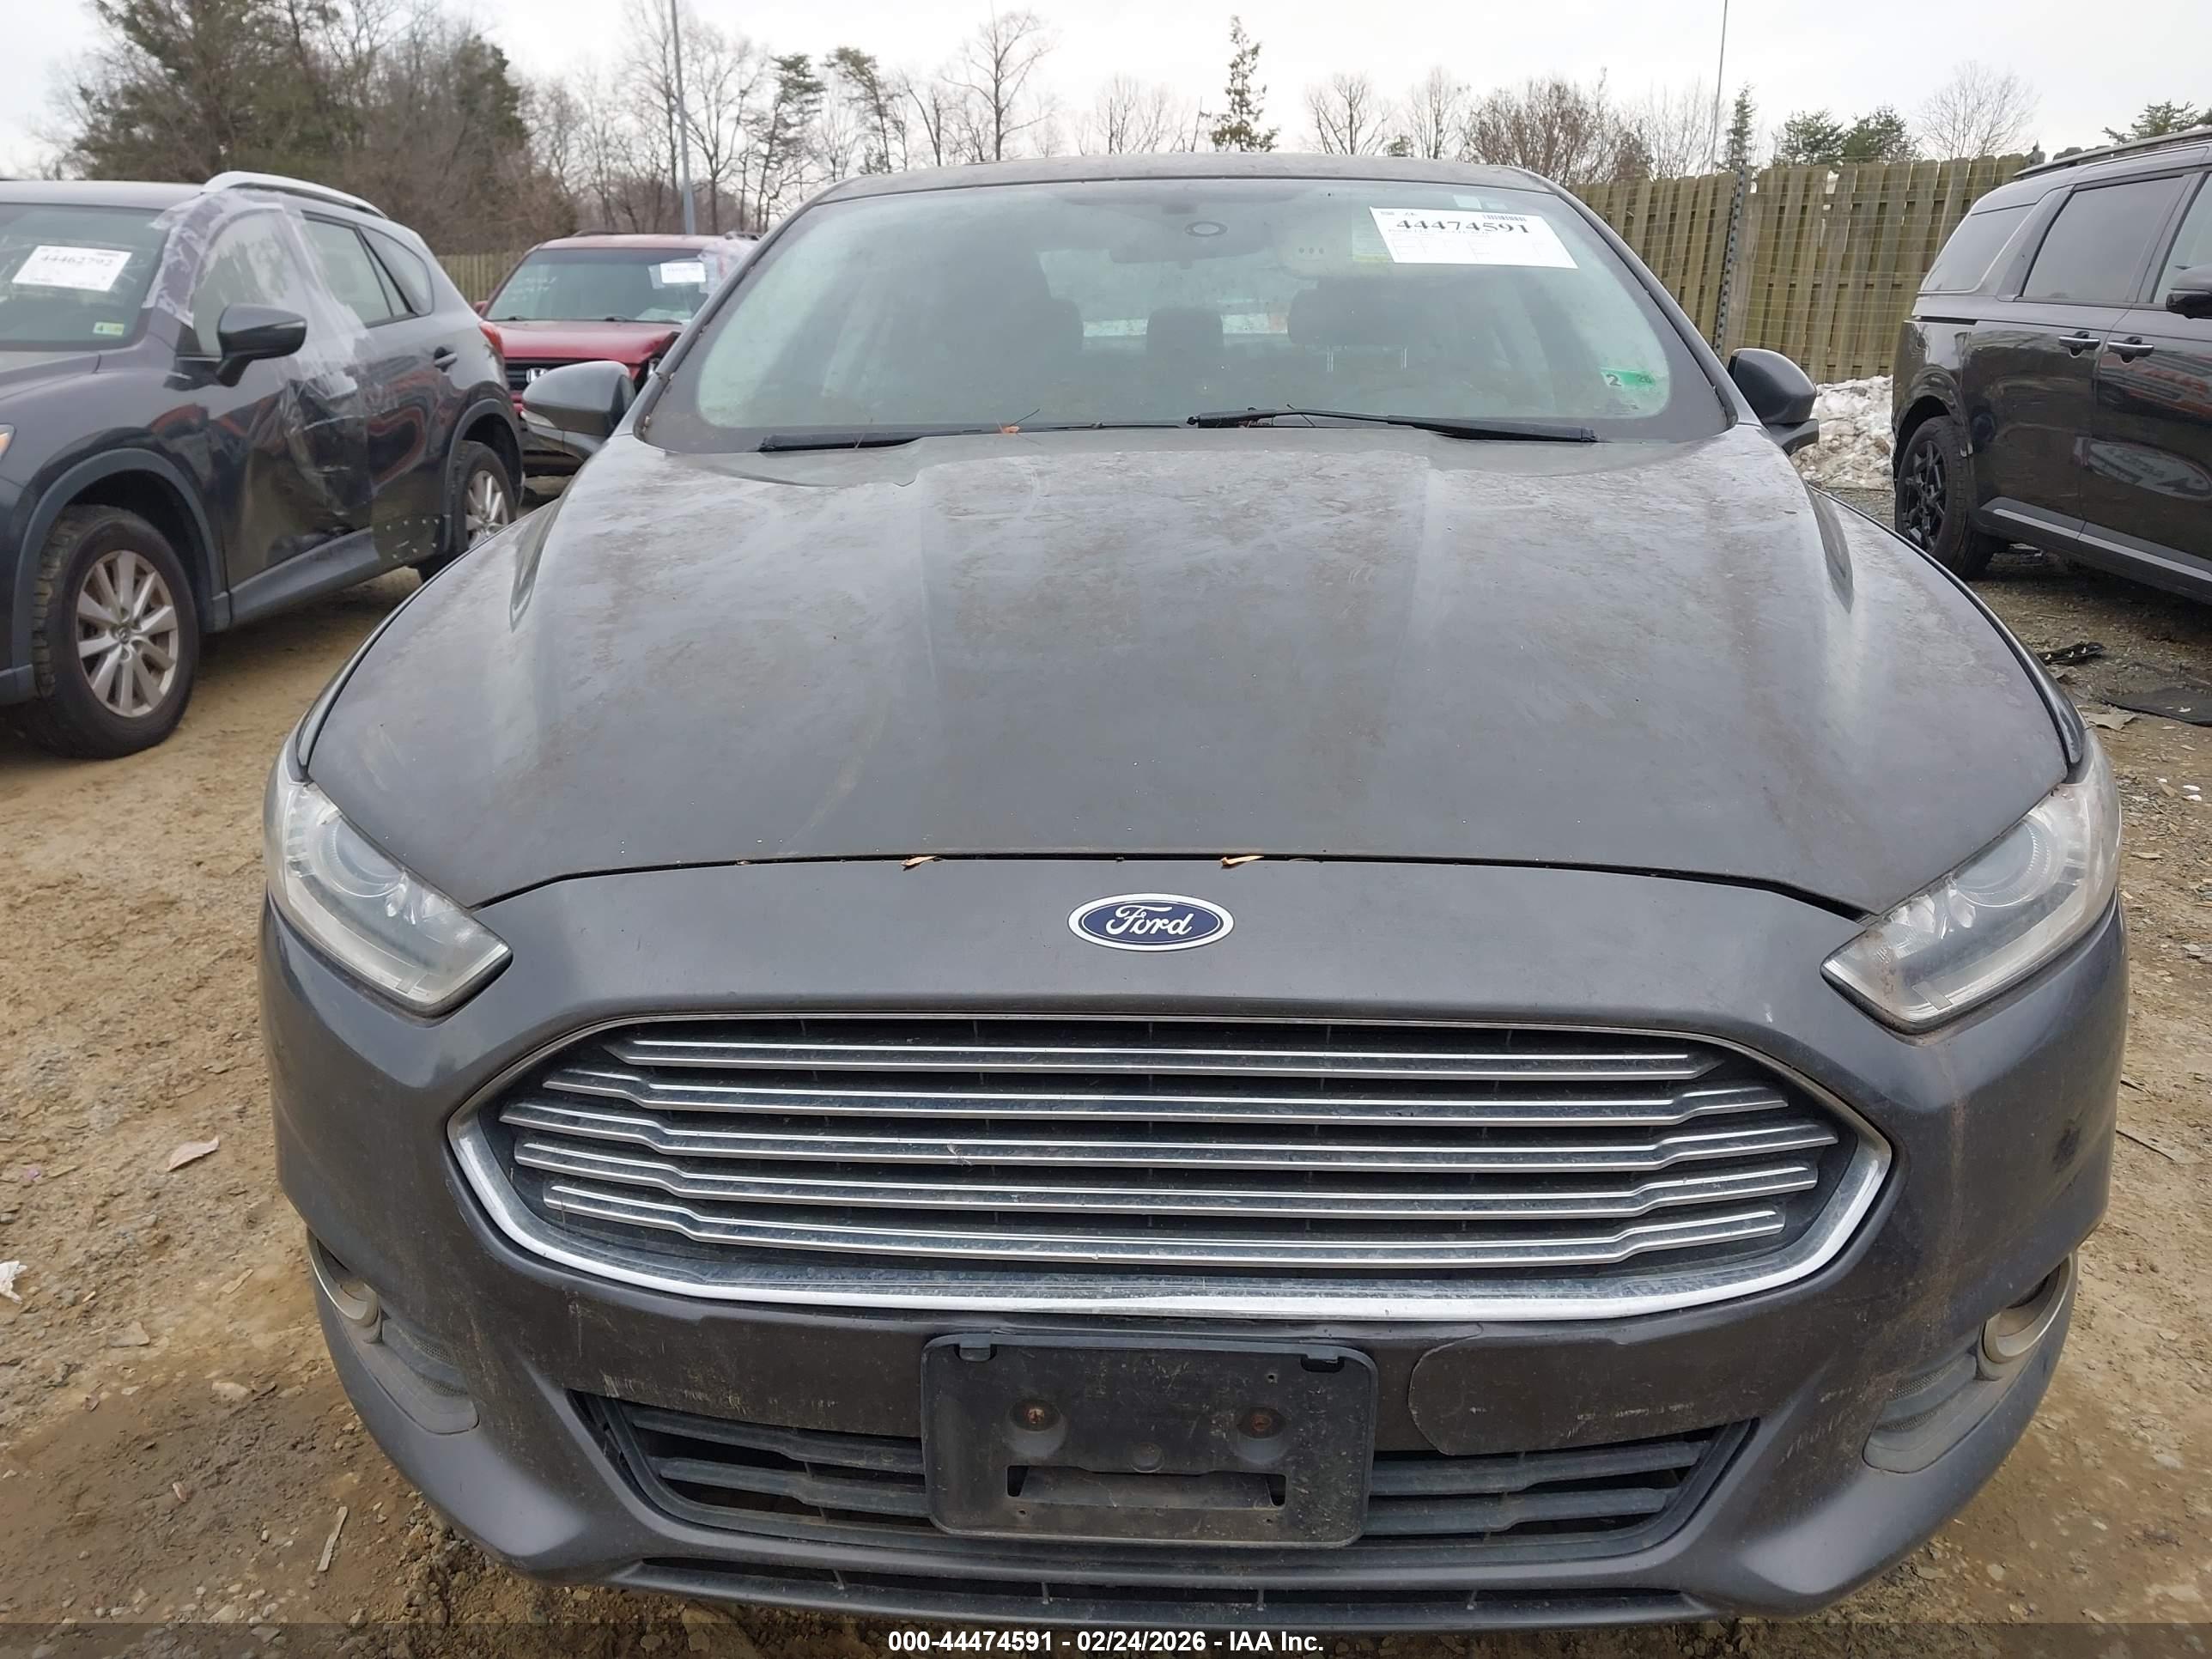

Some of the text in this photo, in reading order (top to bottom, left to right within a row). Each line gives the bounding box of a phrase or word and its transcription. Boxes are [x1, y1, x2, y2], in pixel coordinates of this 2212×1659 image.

[1397, 219, 1529, 234] 44474591
[1606, 374, 1621, 386] 2
[1107, 905, 1194, 935] Ford
